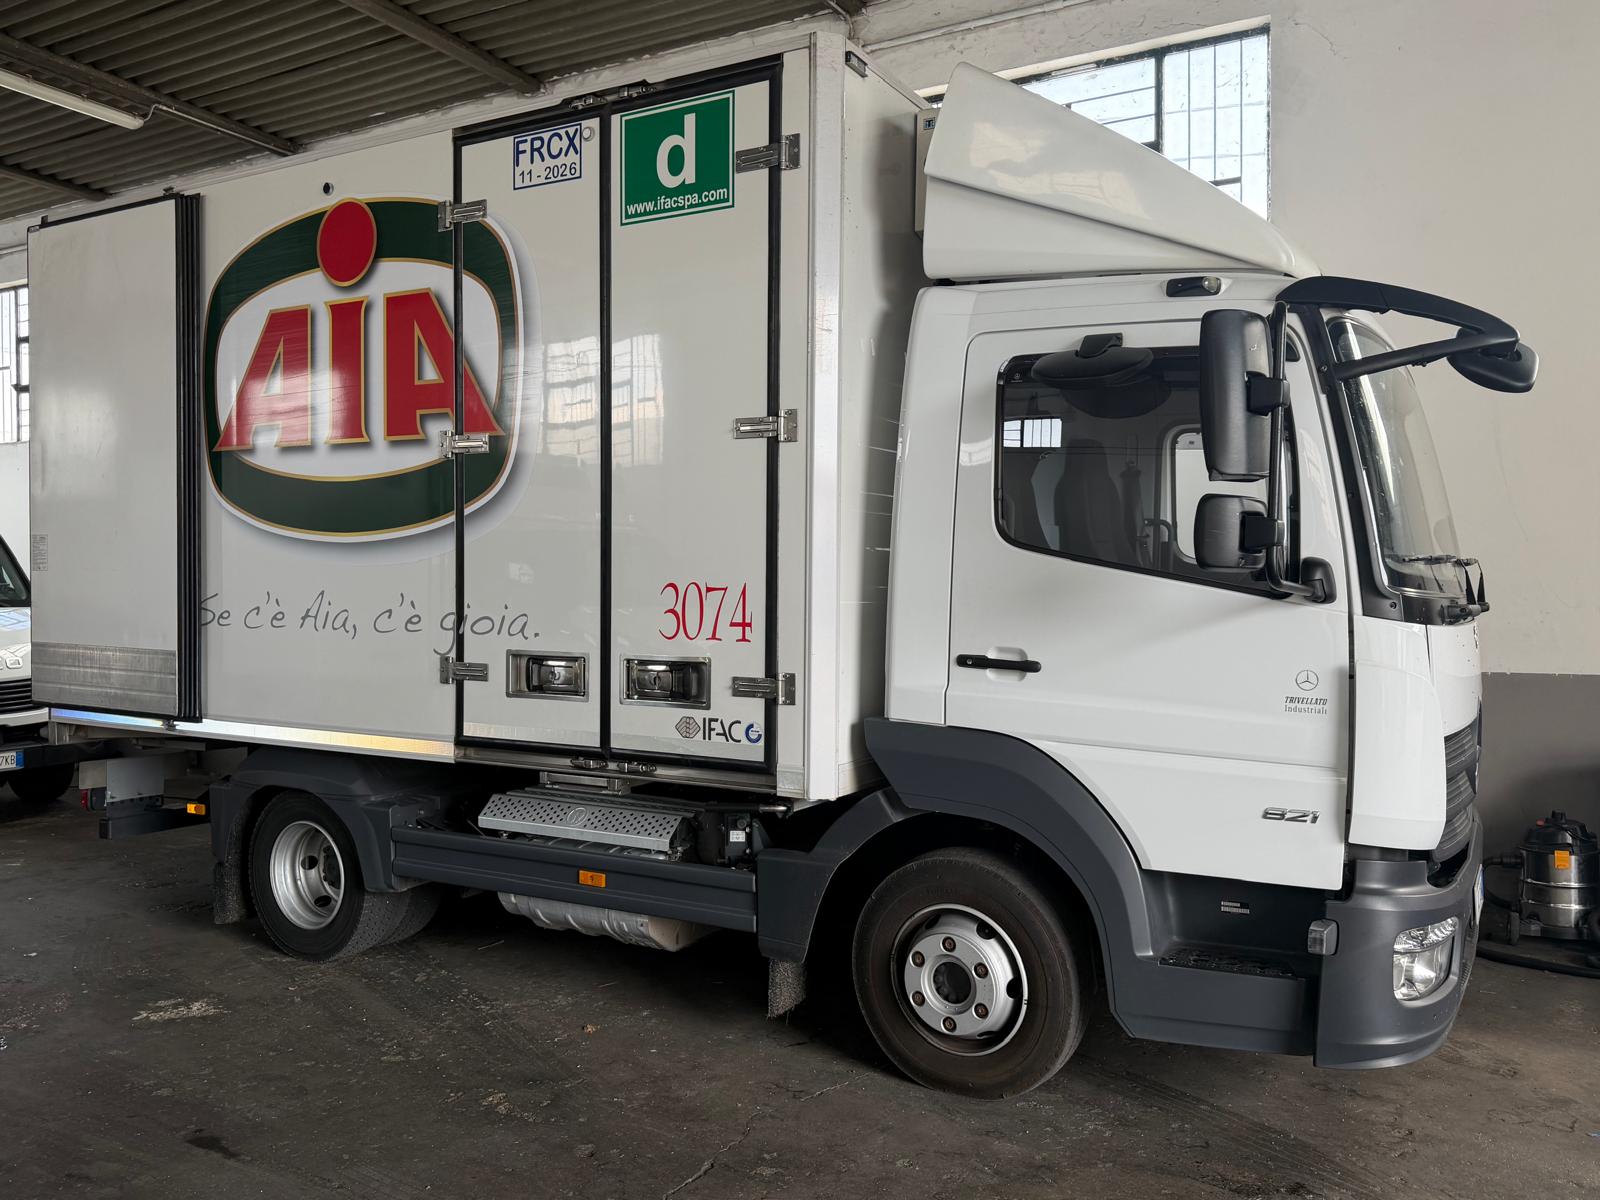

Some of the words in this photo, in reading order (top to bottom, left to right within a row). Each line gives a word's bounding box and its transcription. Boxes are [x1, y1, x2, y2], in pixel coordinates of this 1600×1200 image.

[515, 127, 579, 168] FRCX
[656, 112, 696, 188] d
[626, 187, 729, 216] www.ifacspa.com
[200, 593, 232, 627] Se
[243, 591, 287, 630] c'è
[300, 589, 358, 640] Aia,
[373, 592, 423, 634] c'è
[432, 602, 540, 656] gioia.
[658, 581, 752, 643] 3074
[1284, 696, 1328, 706] TRIVELLATO
[702, 717, 742, 743] IFAC
